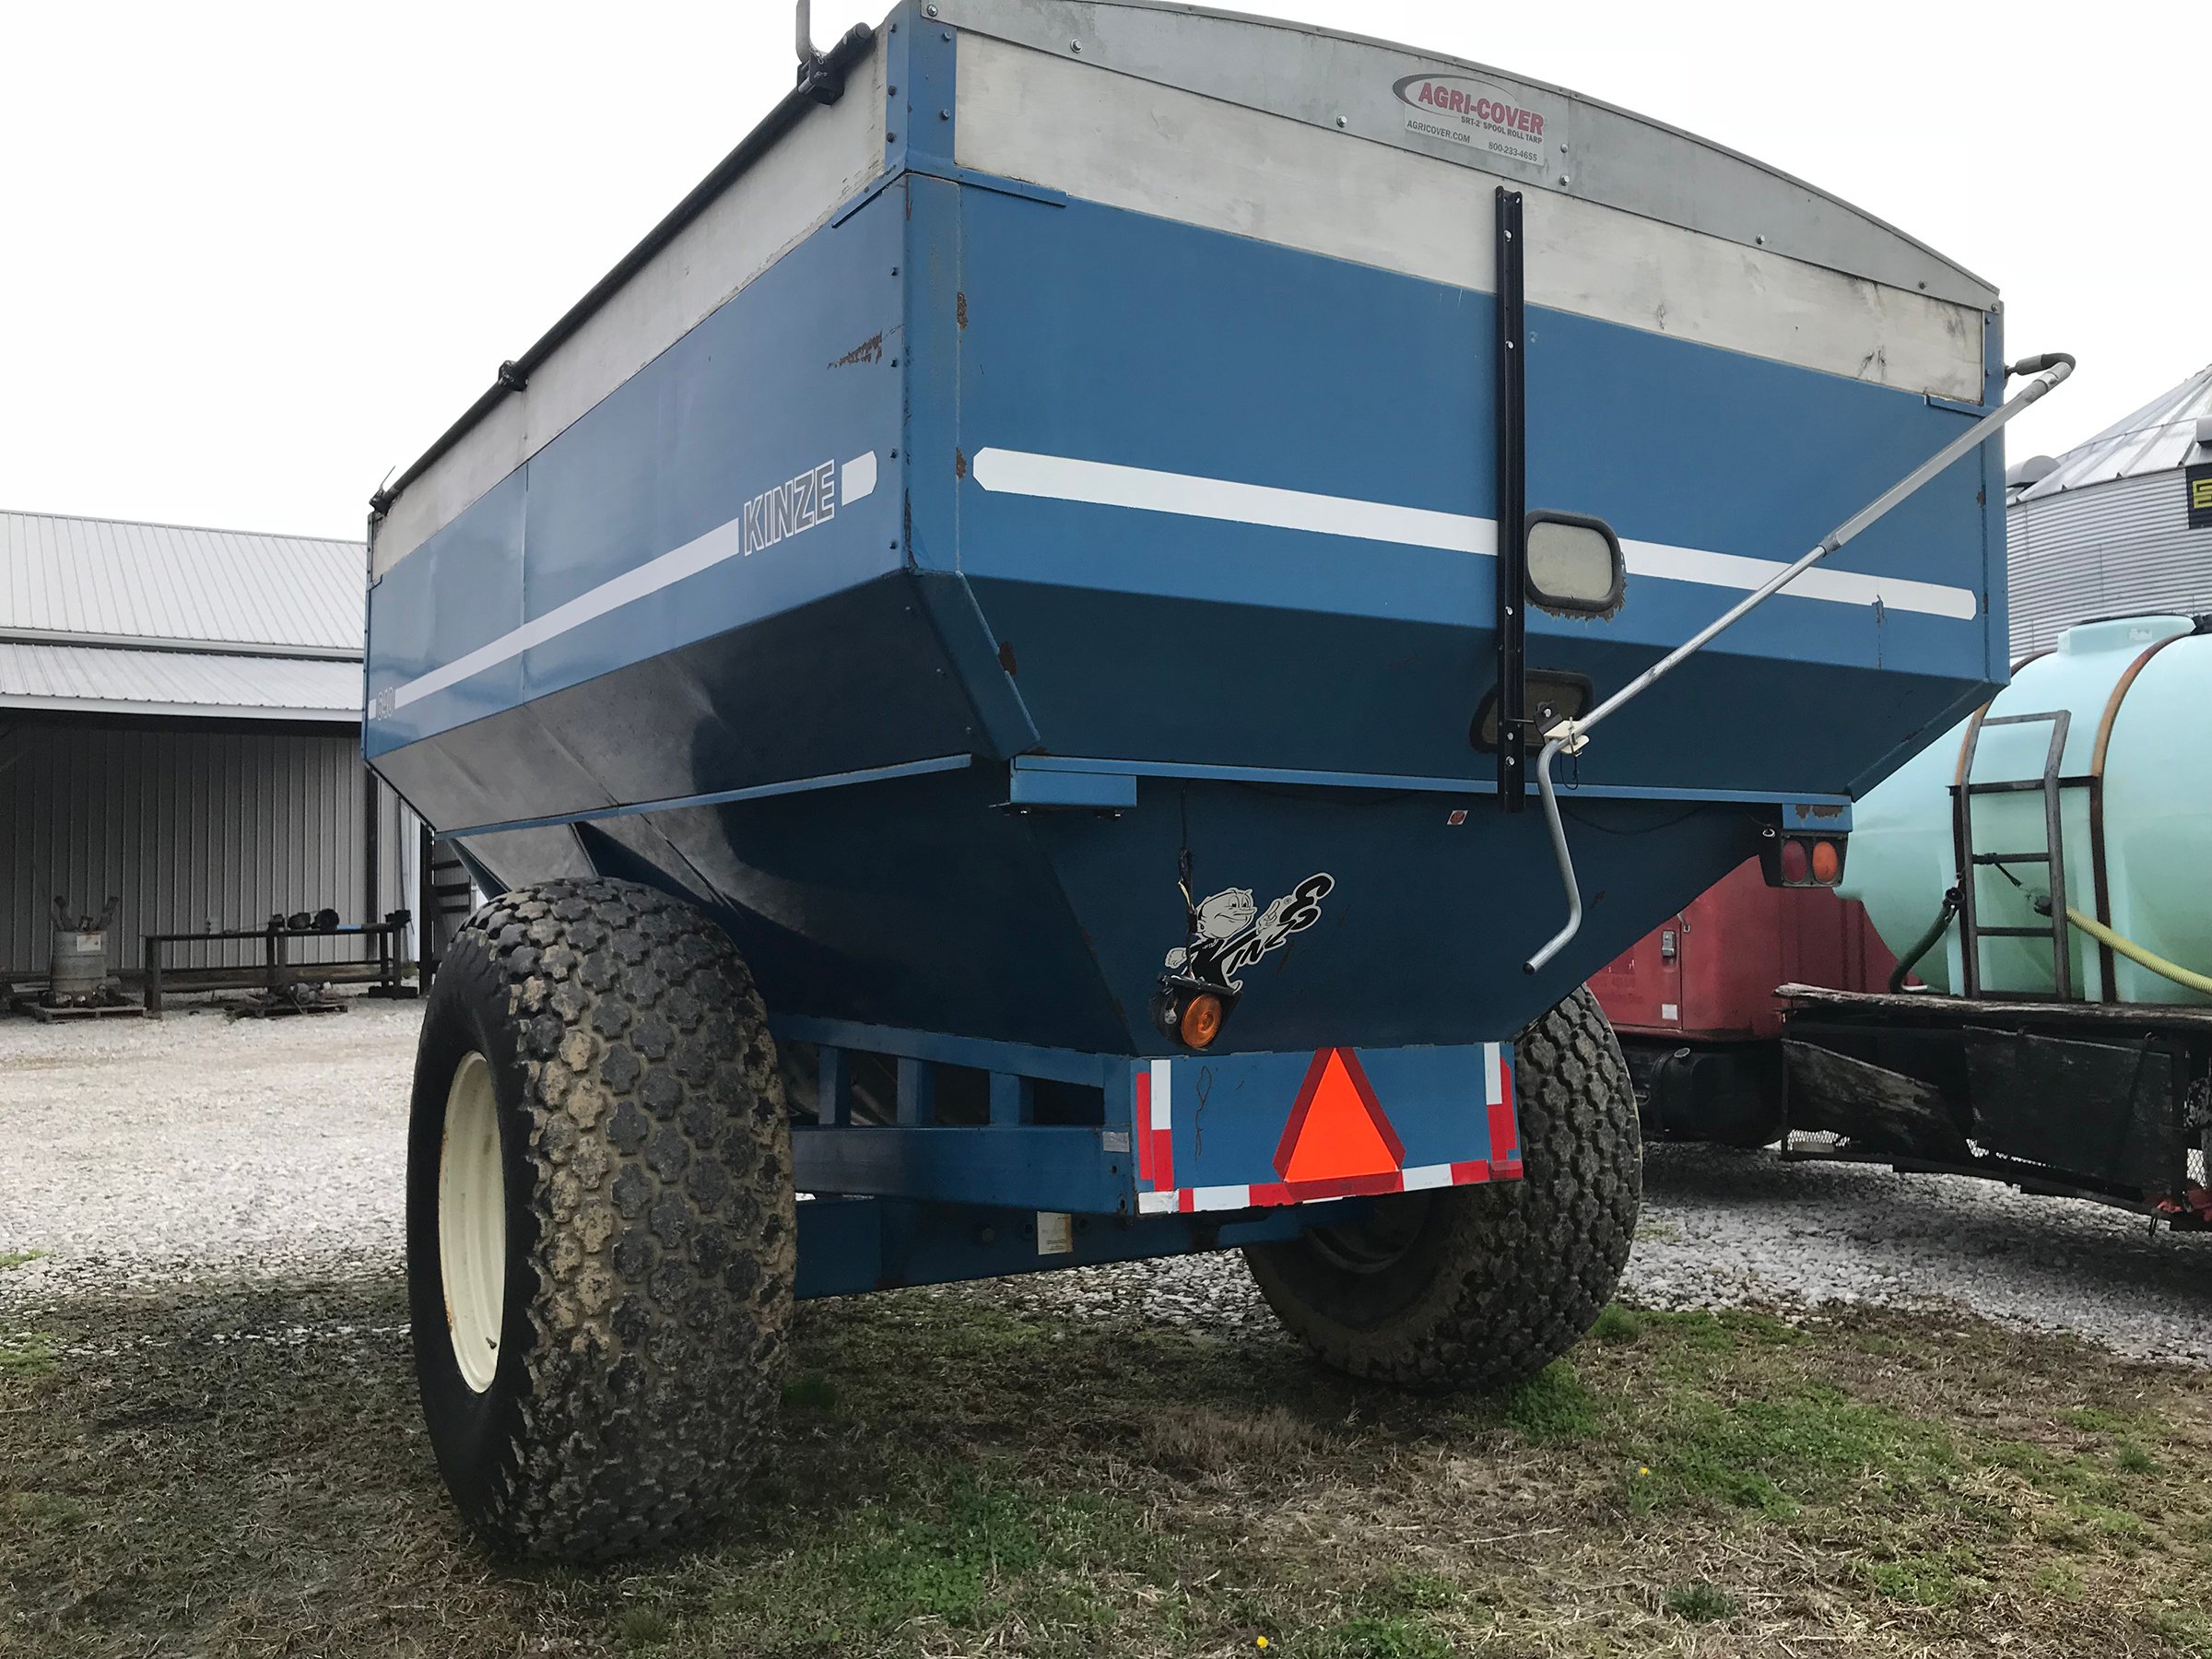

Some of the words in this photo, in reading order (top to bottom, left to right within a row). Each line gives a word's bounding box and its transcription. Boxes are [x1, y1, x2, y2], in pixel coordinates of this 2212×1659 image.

[1418, 81, 1545, 135] AGRI-COVER
[1406, 119, 1471, 144] AGRICOVER.COM
[1483, 122, 1506, 135] SPOOL
[1507, 128, 1524, 140] ROLL
[1524, 133, 1543, 145] TARP
[1488, 141, 1537, 162] 800-233-4655
[744, 458, 835, 557] KINZE
